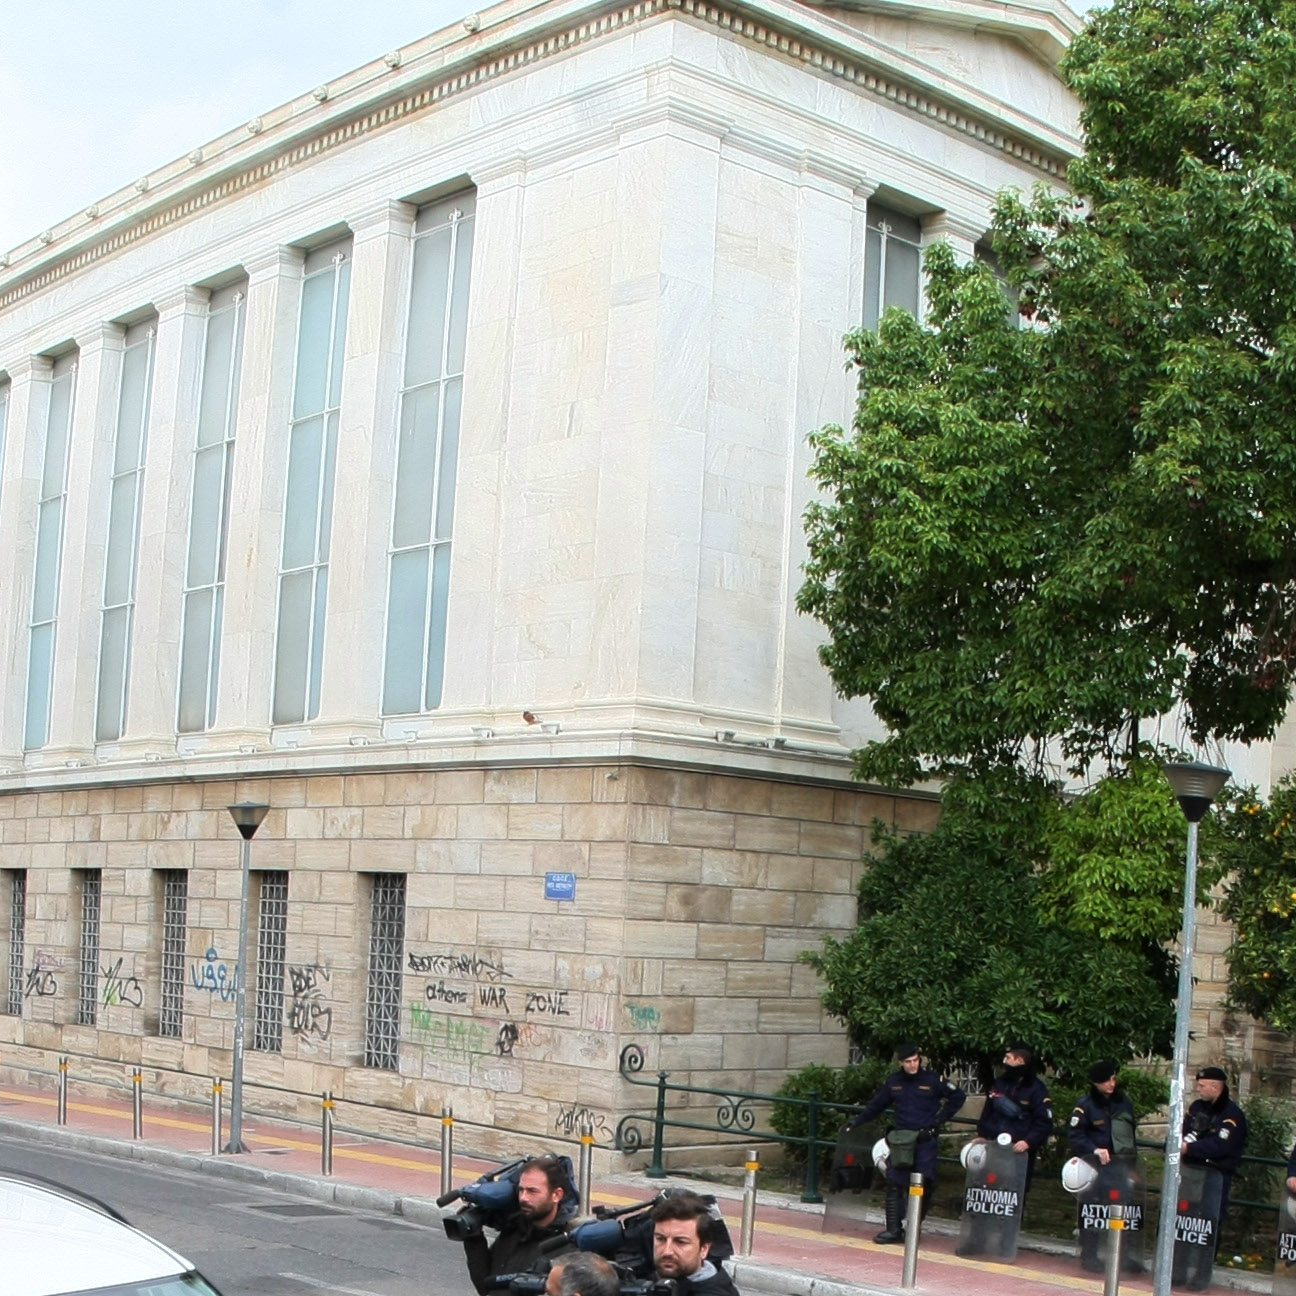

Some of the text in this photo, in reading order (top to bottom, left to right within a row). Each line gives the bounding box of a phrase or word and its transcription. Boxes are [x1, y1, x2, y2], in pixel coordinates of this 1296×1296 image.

[479, 986, 510, 1014] WAR
[525, 991, 570, 1016] ZONE
[966, 1188, 1018, 1206] ΑΣΤΥΝΟΜΙΑ
[966, 1201, 1014, 1217] POLICE
[1081, 1204, 1142, 1219] ΑΣΤΥΜΙΑ
[1084, 1217, 1139, 1231] POCE
